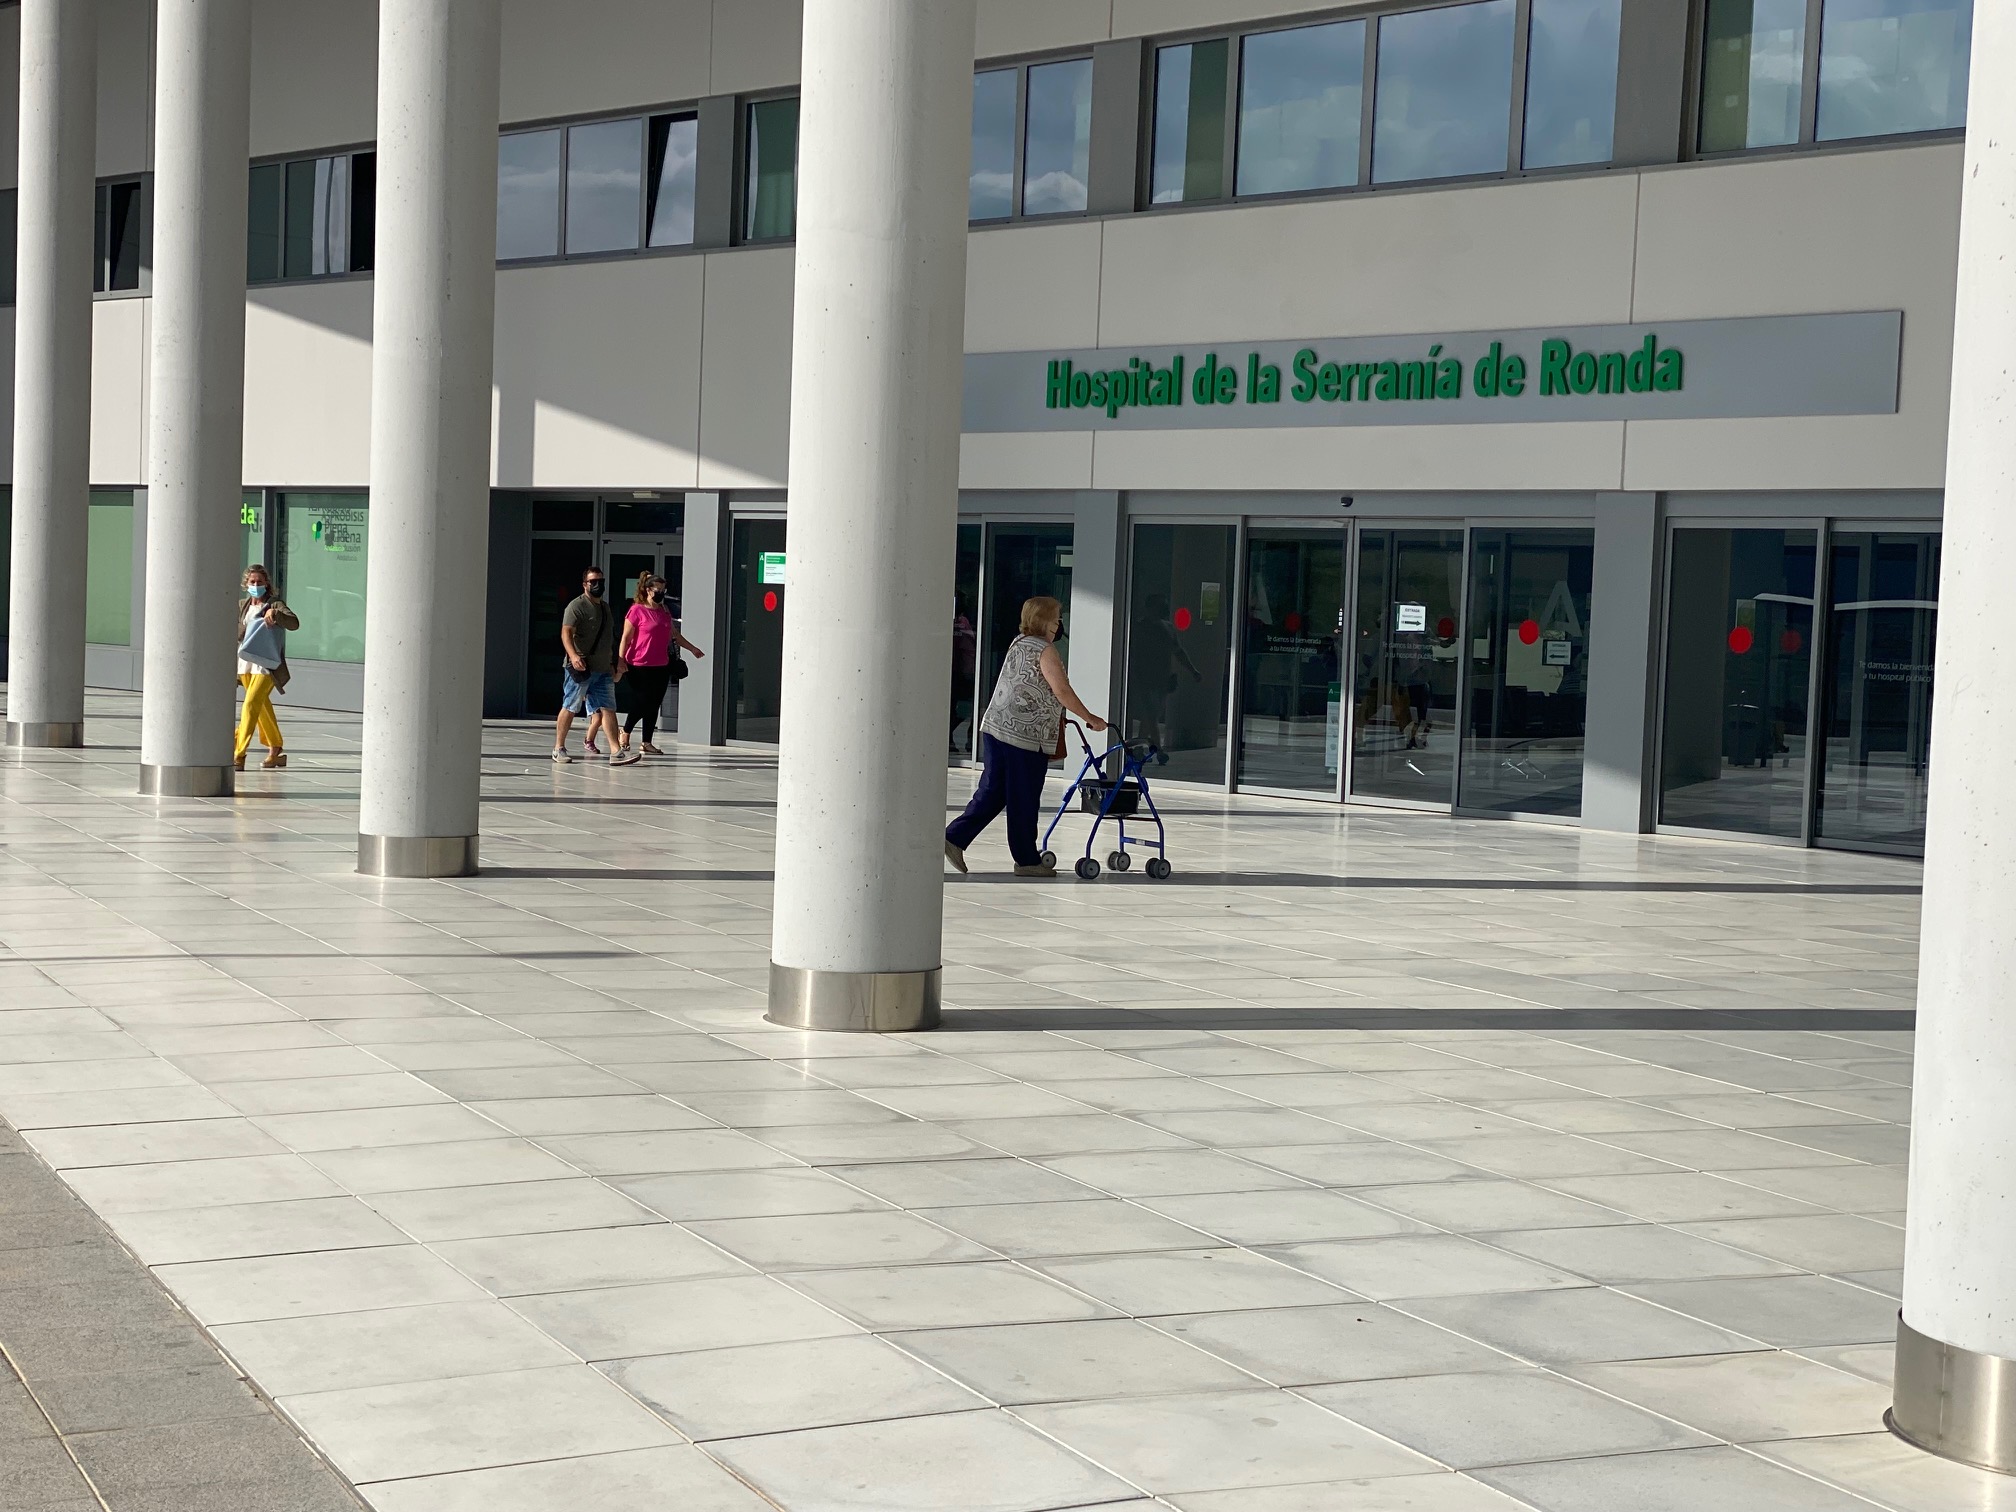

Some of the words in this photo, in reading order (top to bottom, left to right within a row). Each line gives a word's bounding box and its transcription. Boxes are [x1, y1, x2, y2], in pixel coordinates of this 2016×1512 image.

[1046, 355, 1183, 419] Hospital
[1192, 352, 1237, 406] de
[1246, 352, 1280, 404] la
[1291, 345, 1462, 404] Serranía
[1473, 341, 1527, 398] de
[1539, 333, 1684, 397] Ronda
[1900, 663, 1935, 671] bienvenid
